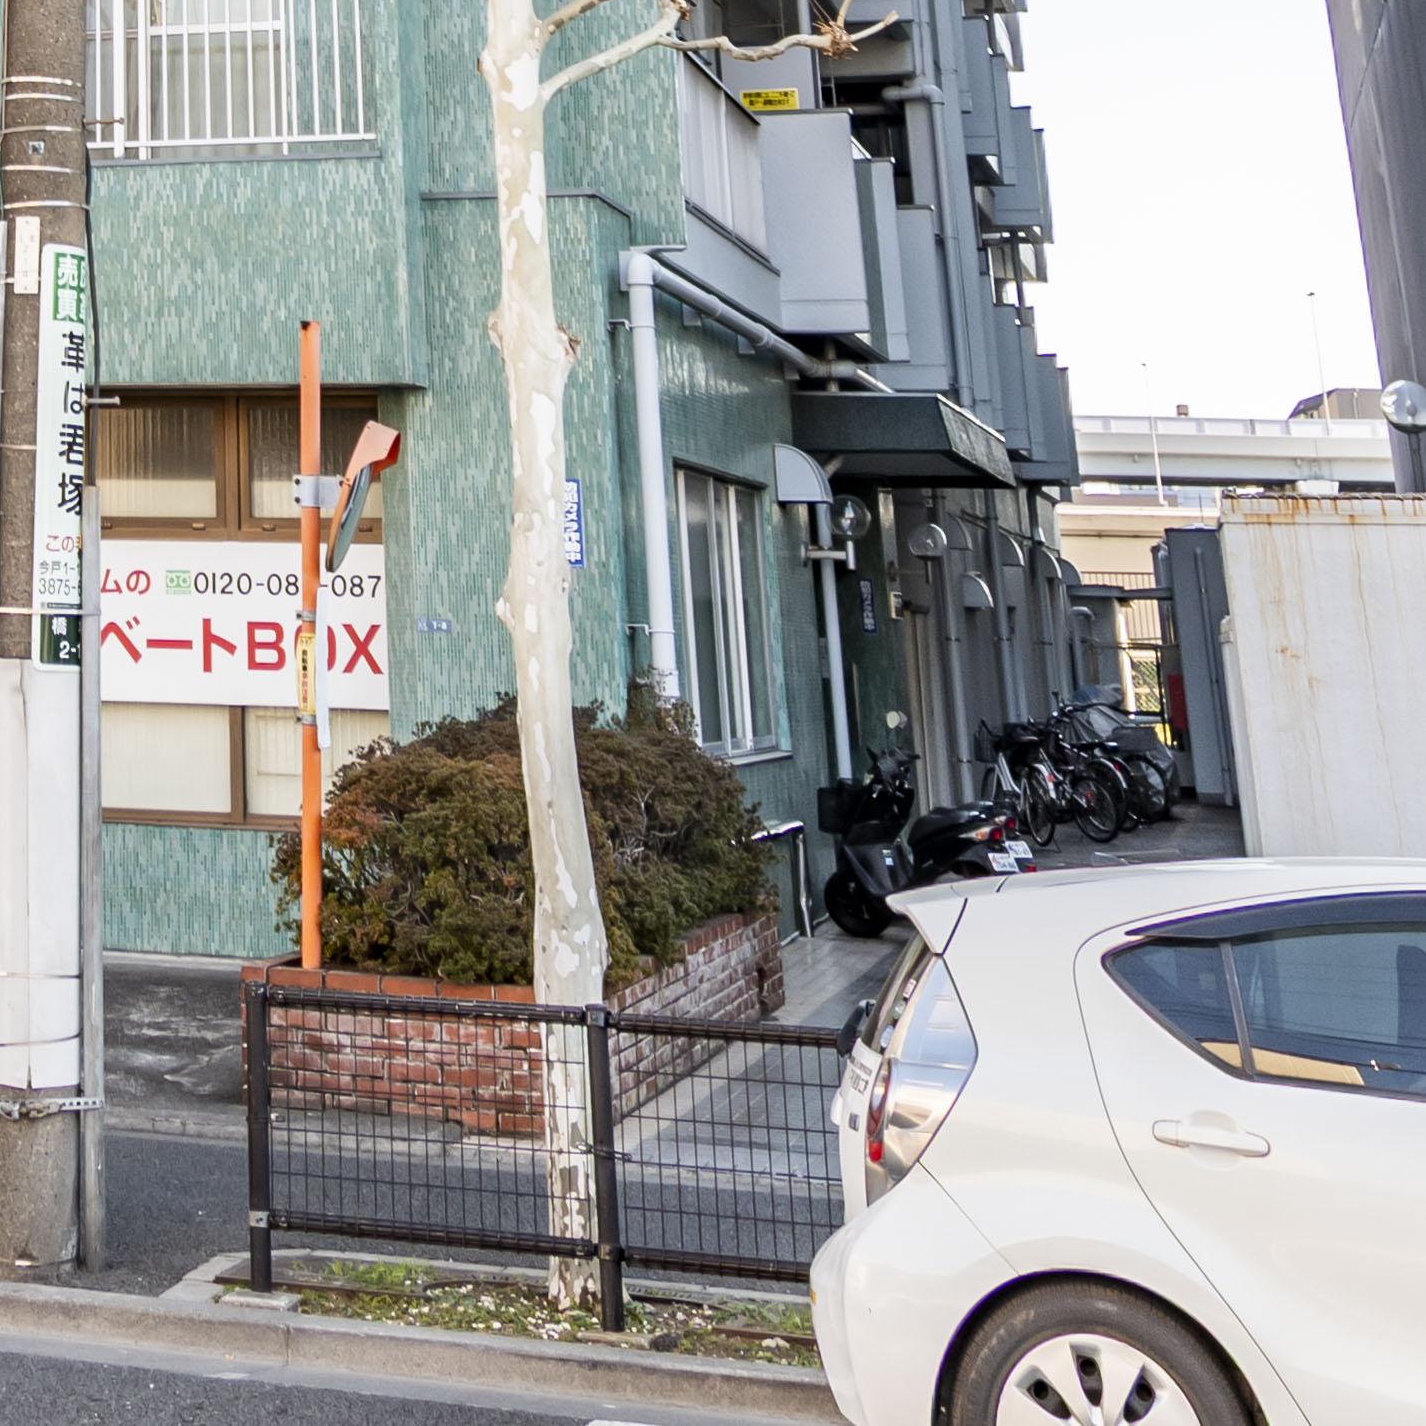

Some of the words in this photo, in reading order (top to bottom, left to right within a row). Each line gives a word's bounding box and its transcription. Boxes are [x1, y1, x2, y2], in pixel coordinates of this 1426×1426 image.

[56, 254, 78, 321] 売買
[46, 534, 81, 552] この
[39, 560, 80, 574] 今戸1-
[39, 578, 81, 596] 3875-
[194, 572, 381, 598] 0120-08-087
